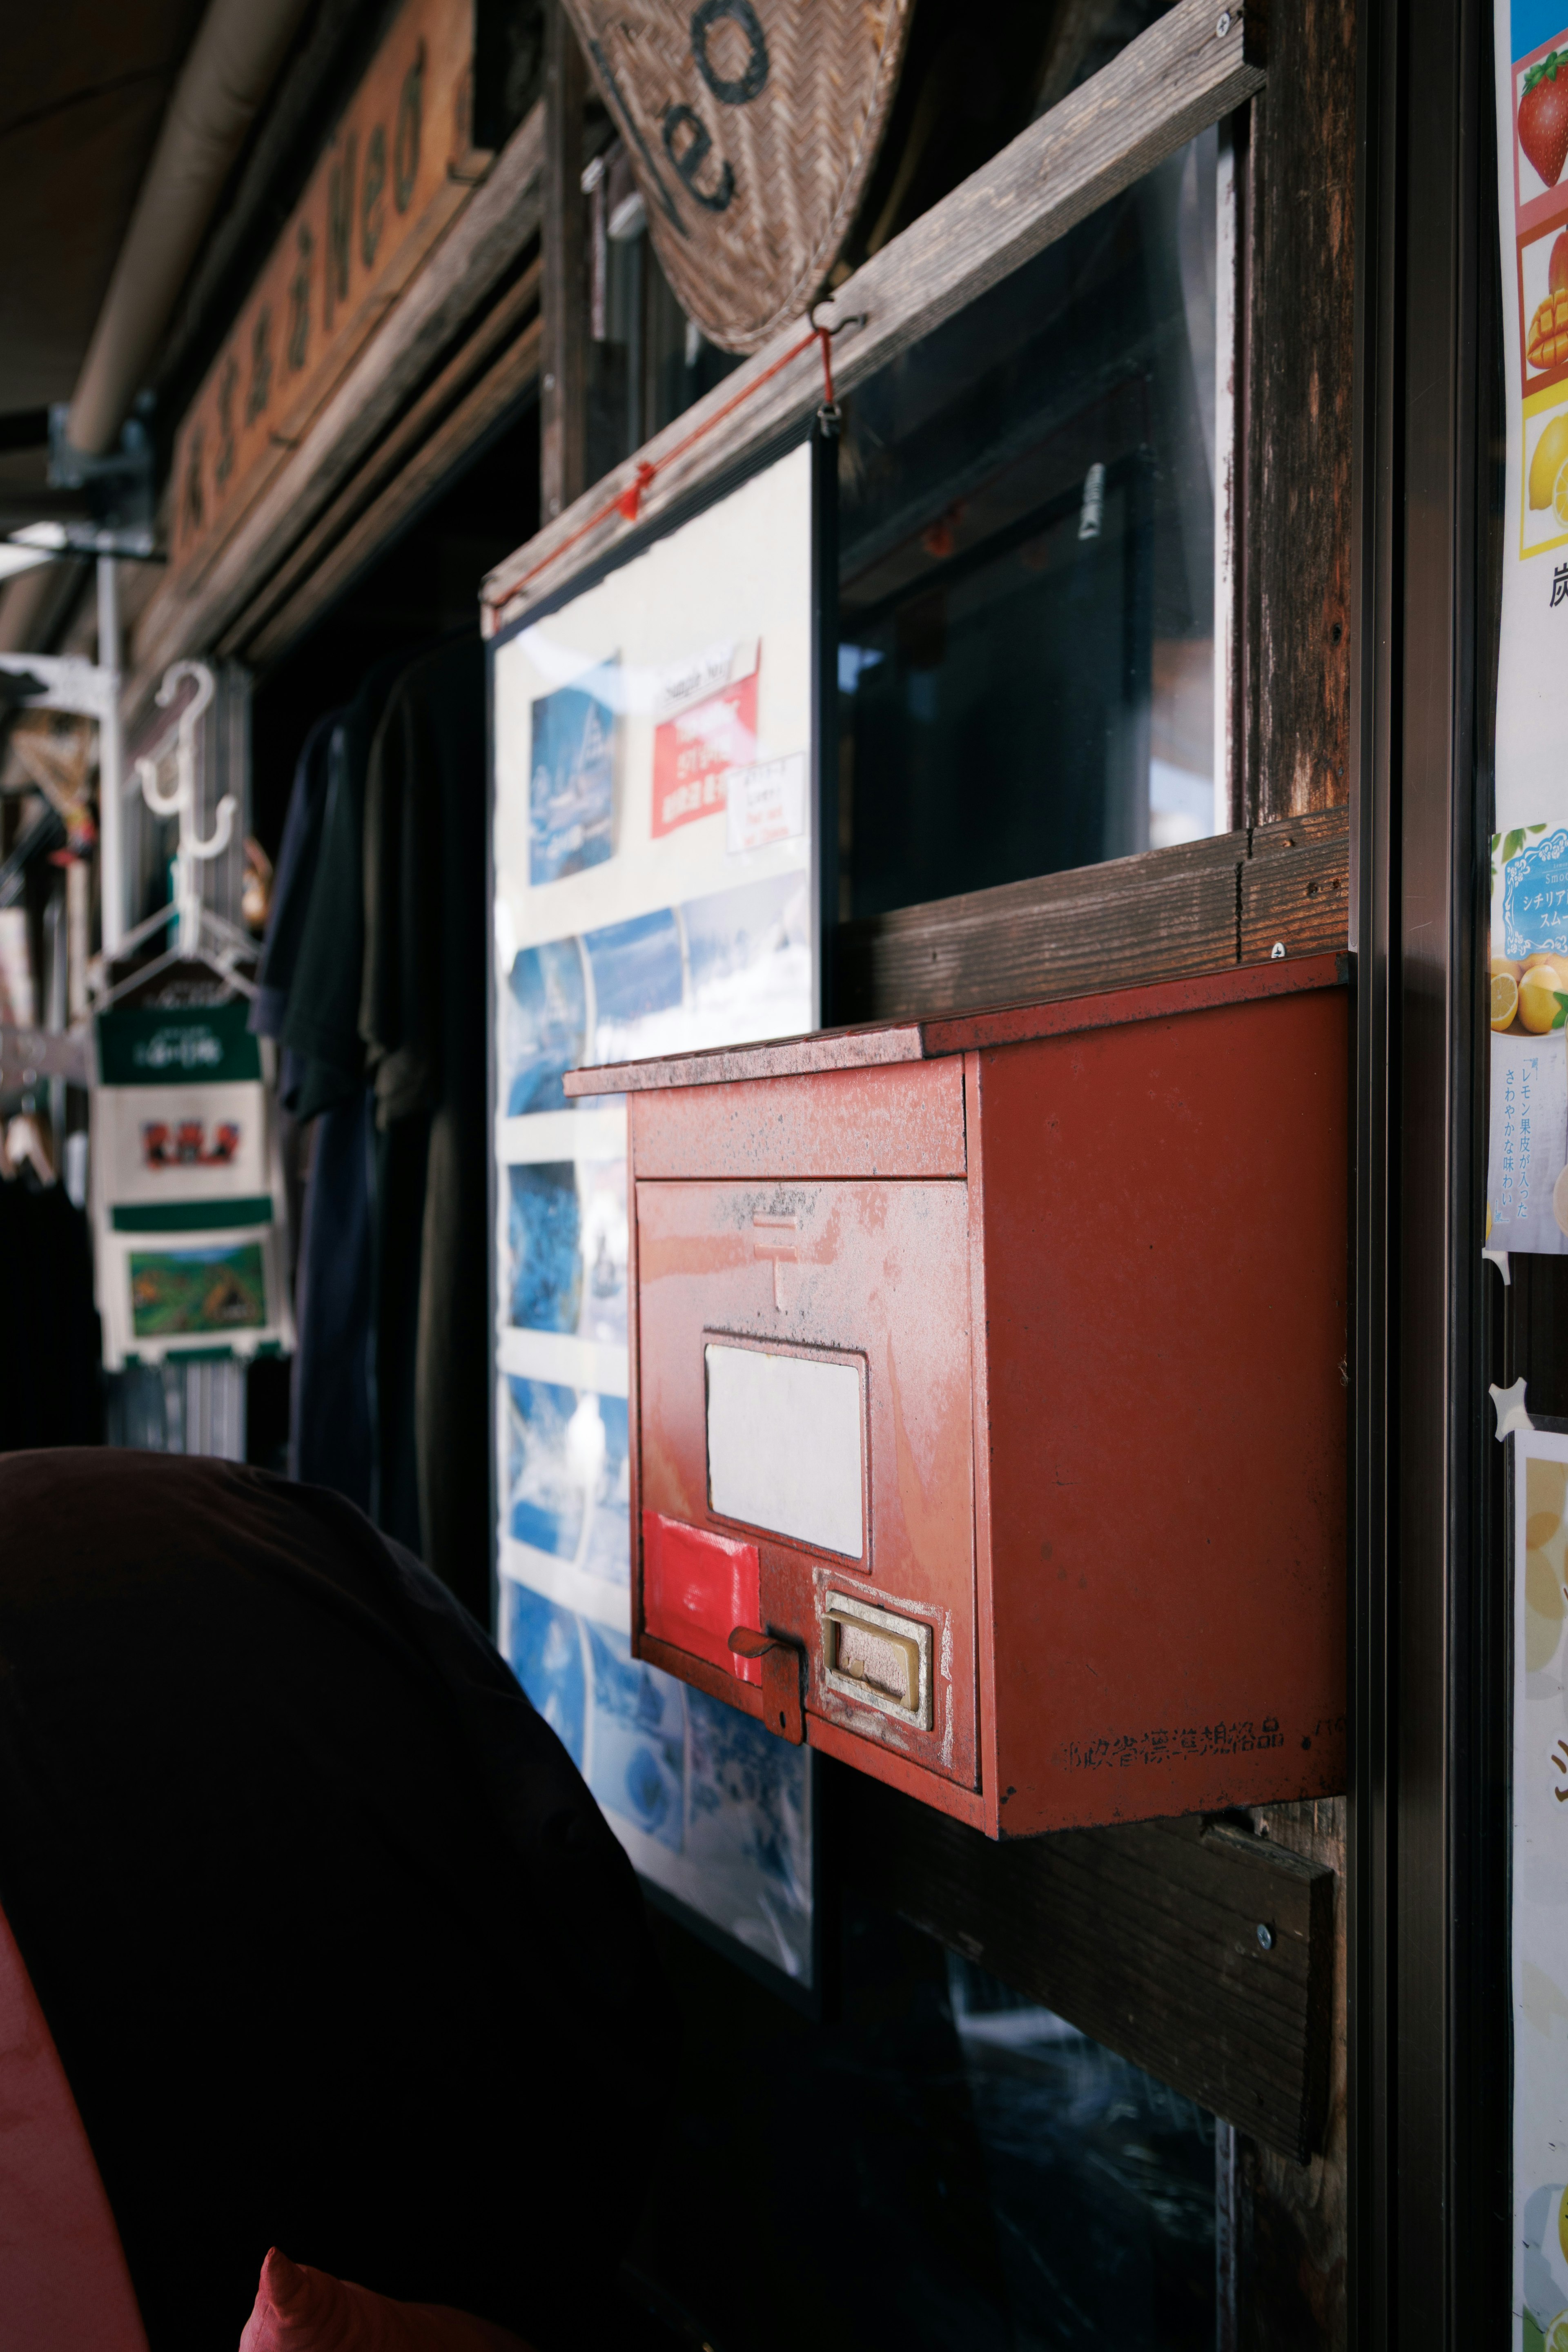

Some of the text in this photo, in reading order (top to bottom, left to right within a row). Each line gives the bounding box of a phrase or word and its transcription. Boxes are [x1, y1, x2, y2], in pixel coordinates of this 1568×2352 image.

[1523, 889, 1568, 911] シチリア
[1502, 1069, 1515, 1207] さわやかな味わい
[1517, 1067, 1531, 1218] レモン果皮が入った
